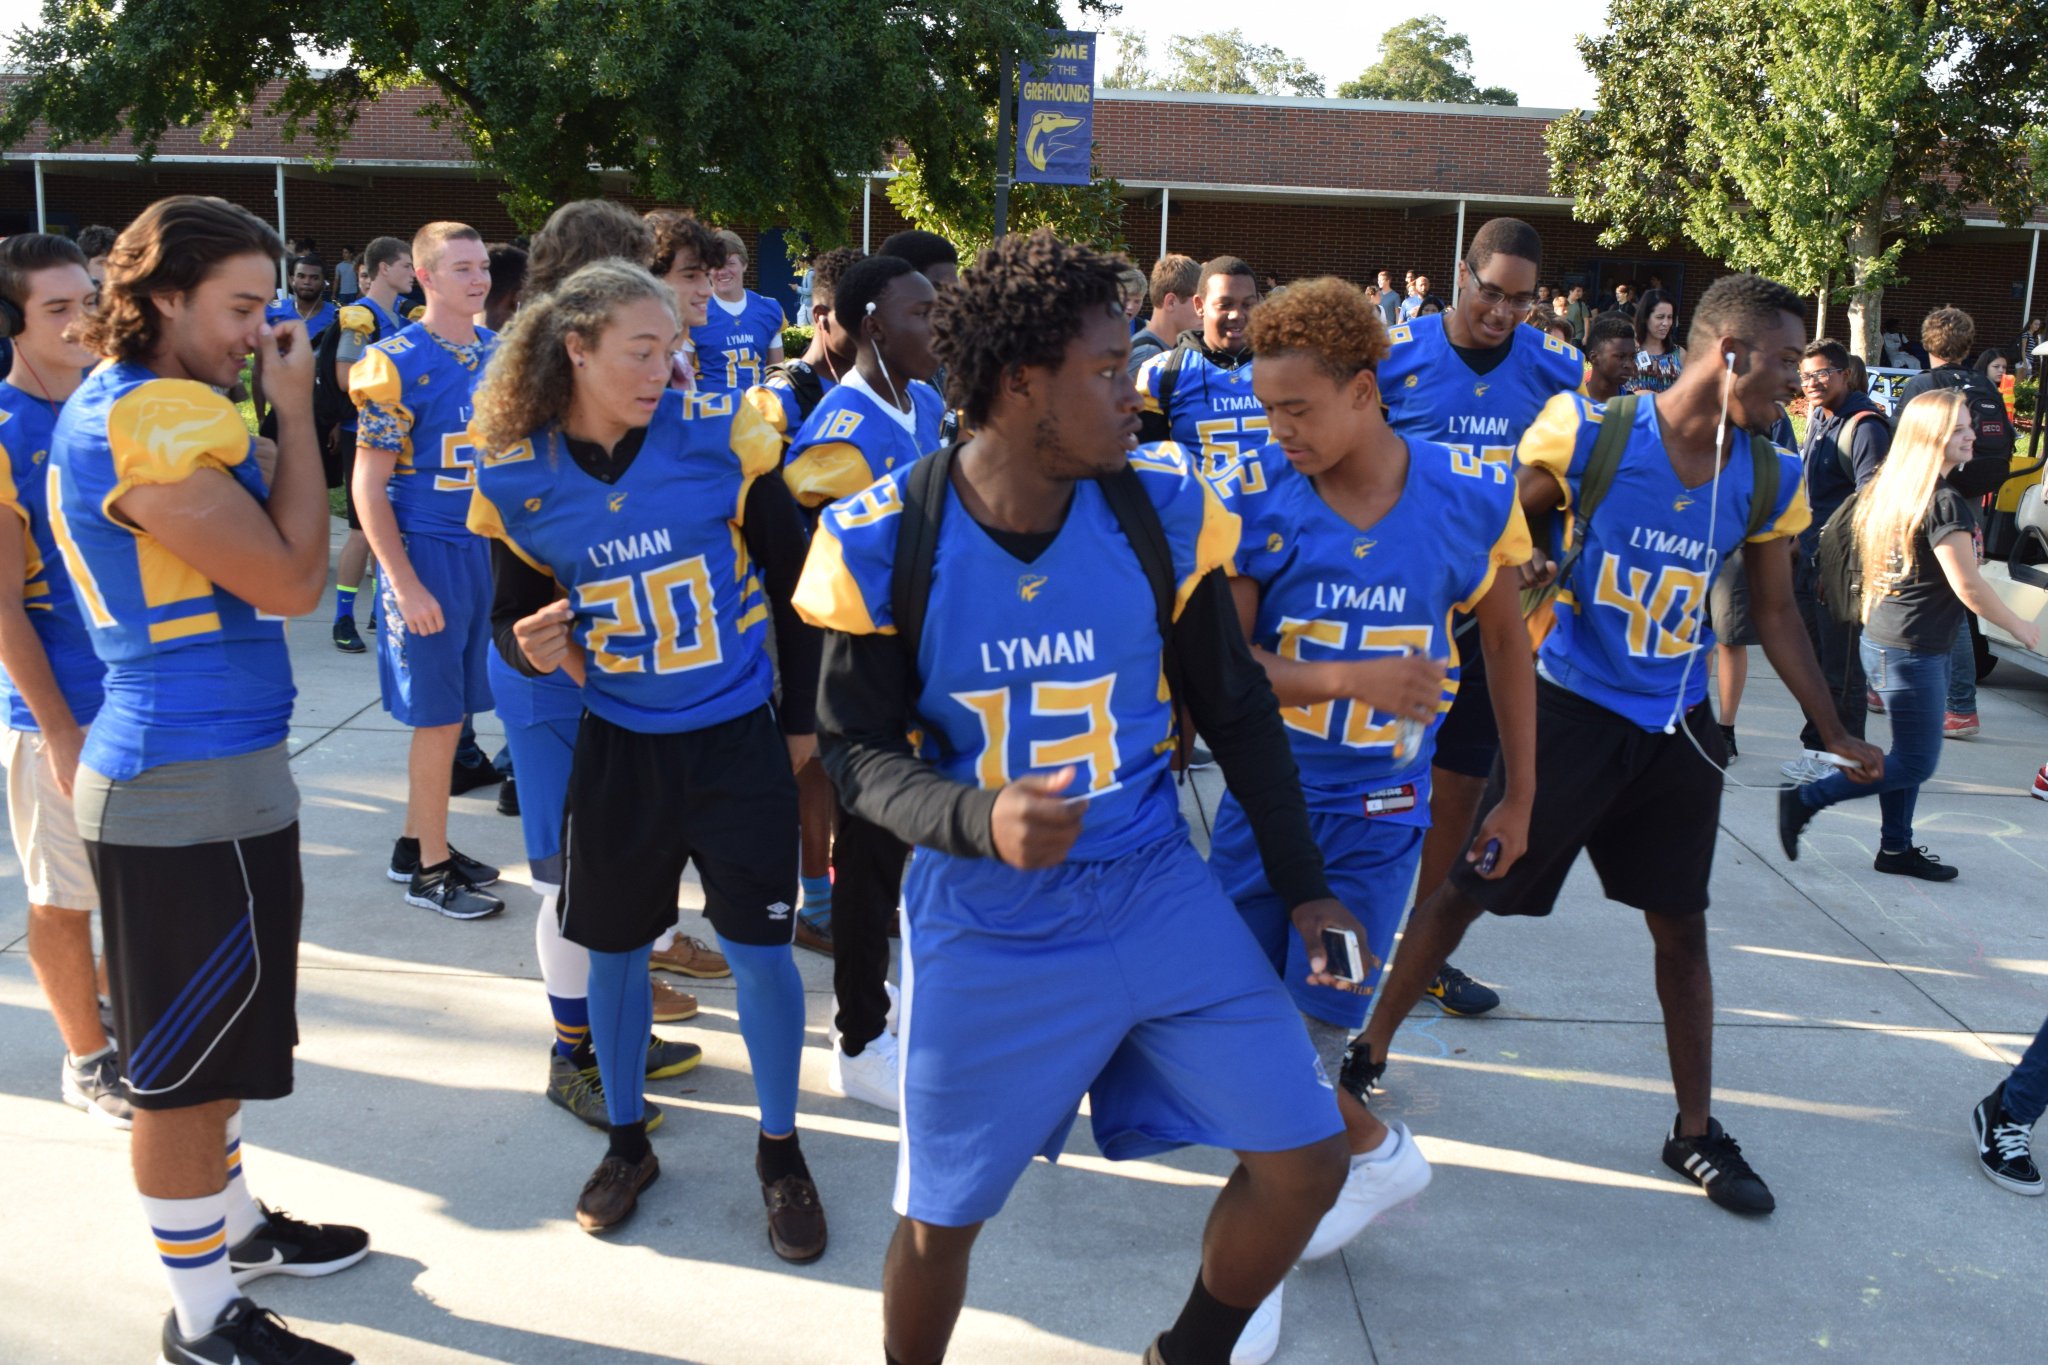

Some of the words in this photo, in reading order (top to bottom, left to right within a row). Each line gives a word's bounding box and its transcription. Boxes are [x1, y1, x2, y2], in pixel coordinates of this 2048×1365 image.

[1048, 45, 1088, 59] ME
[1058, 65, 1077, 76] THE
[1024, 82, 1090, 102] GREYHOUNDS
[726, 334, 754, 346] LYMAN
[721, 347, 762, 388] 14
[1213, 396, 1263, 412] LYMAN
[813, 408, 865, 440] 18
[1449, 416, 1509, 436] LYMAN
[588, 528, 673, 568] LYMAN
[1629, 526, 1705, 561] LYMAN
[1317, 582, 1406, 613] LYMAN
[1593, 551, 1711, 658] 40
[575, 554, 724, 674] 20
[980, 629, 1095, 673] LYMAN
[948, 672, 1123, 804] 13
